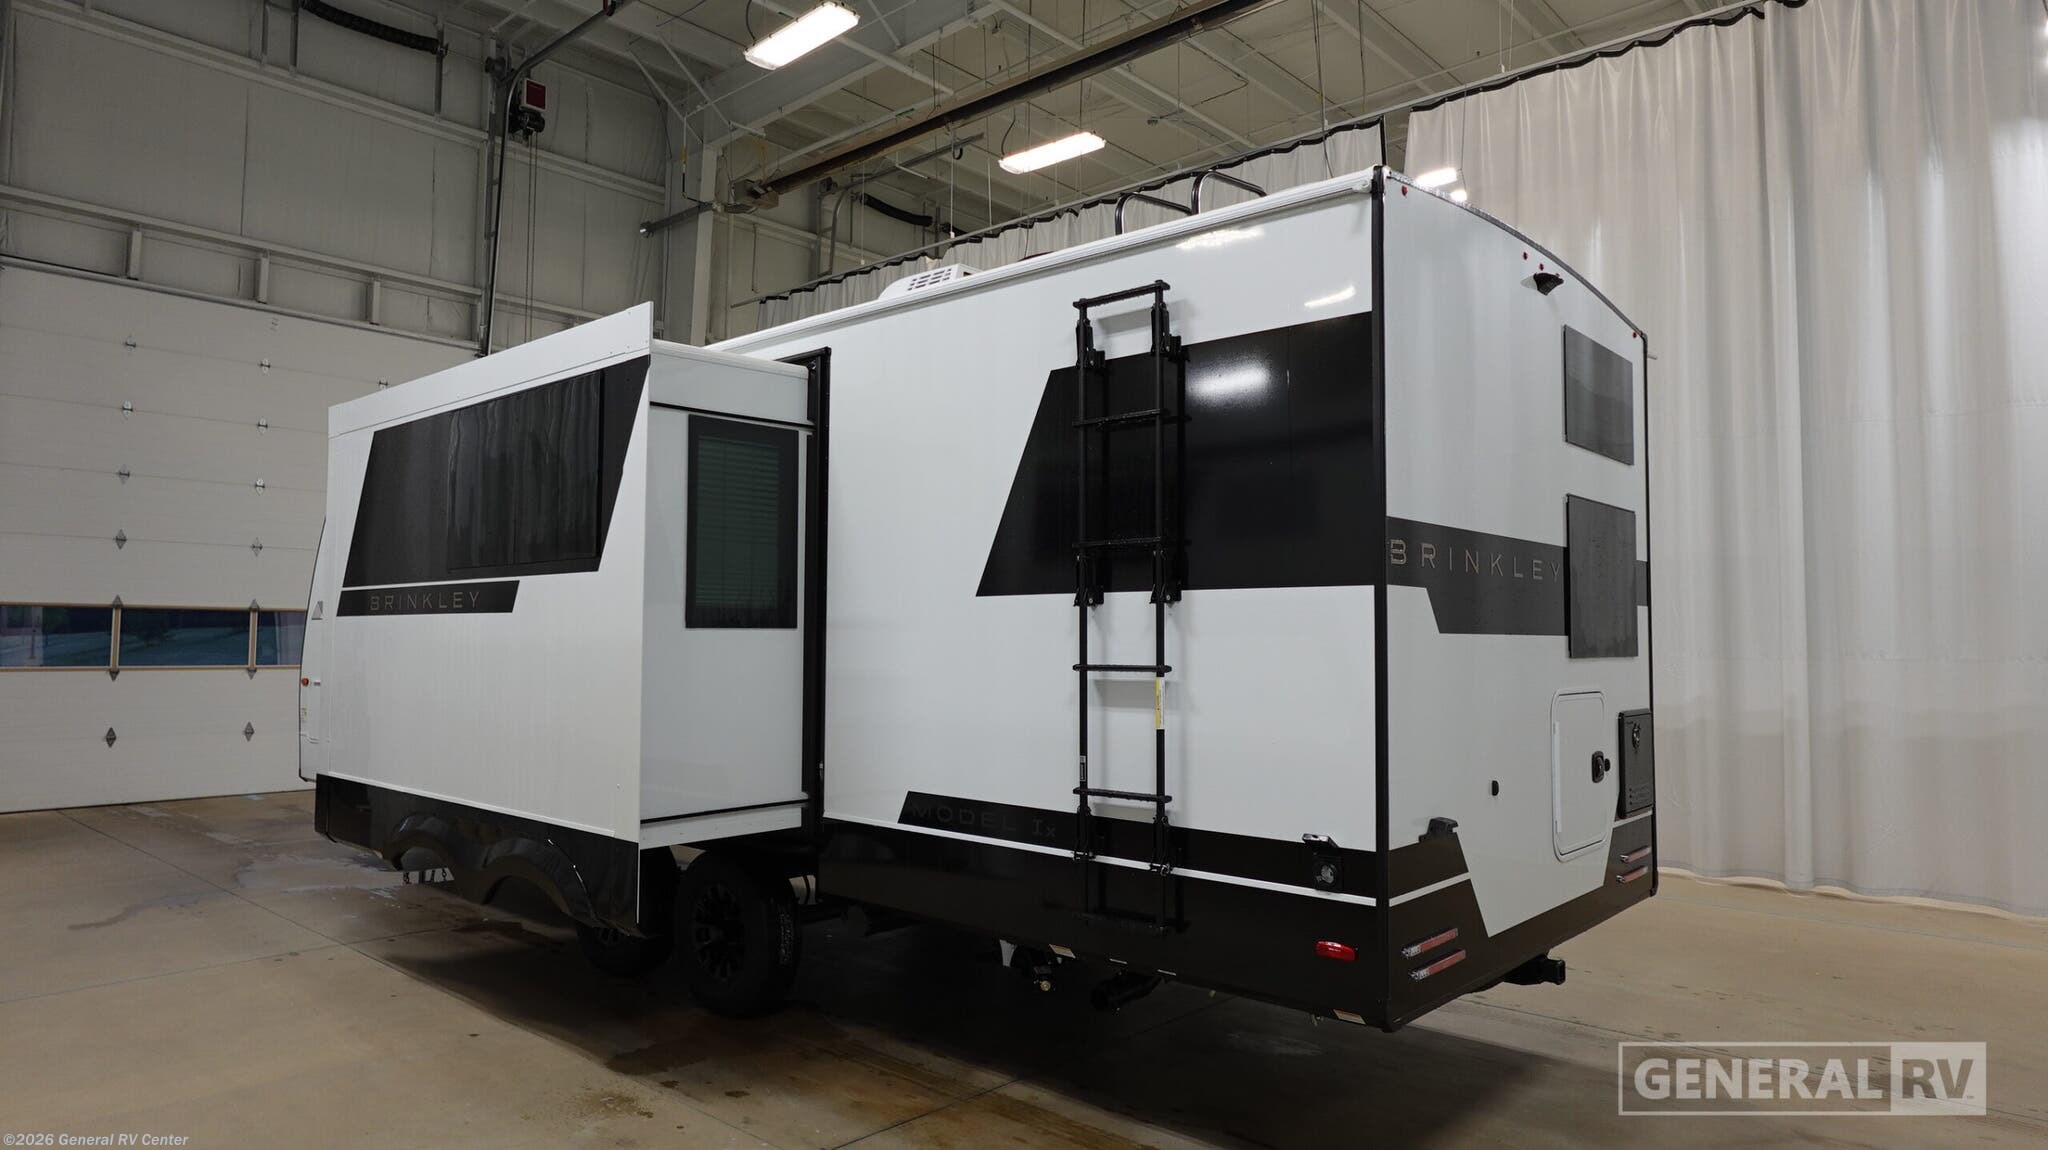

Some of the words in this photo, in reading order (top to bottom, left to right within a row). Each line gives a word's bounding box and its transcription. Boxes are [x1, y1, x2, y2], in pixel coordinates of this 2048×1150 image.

[1389, 539, 1562, 582] BRINKLEY
[369, 591, 480, 611] BRINKLEY
[912, 804, 1017, 832] MODEL
